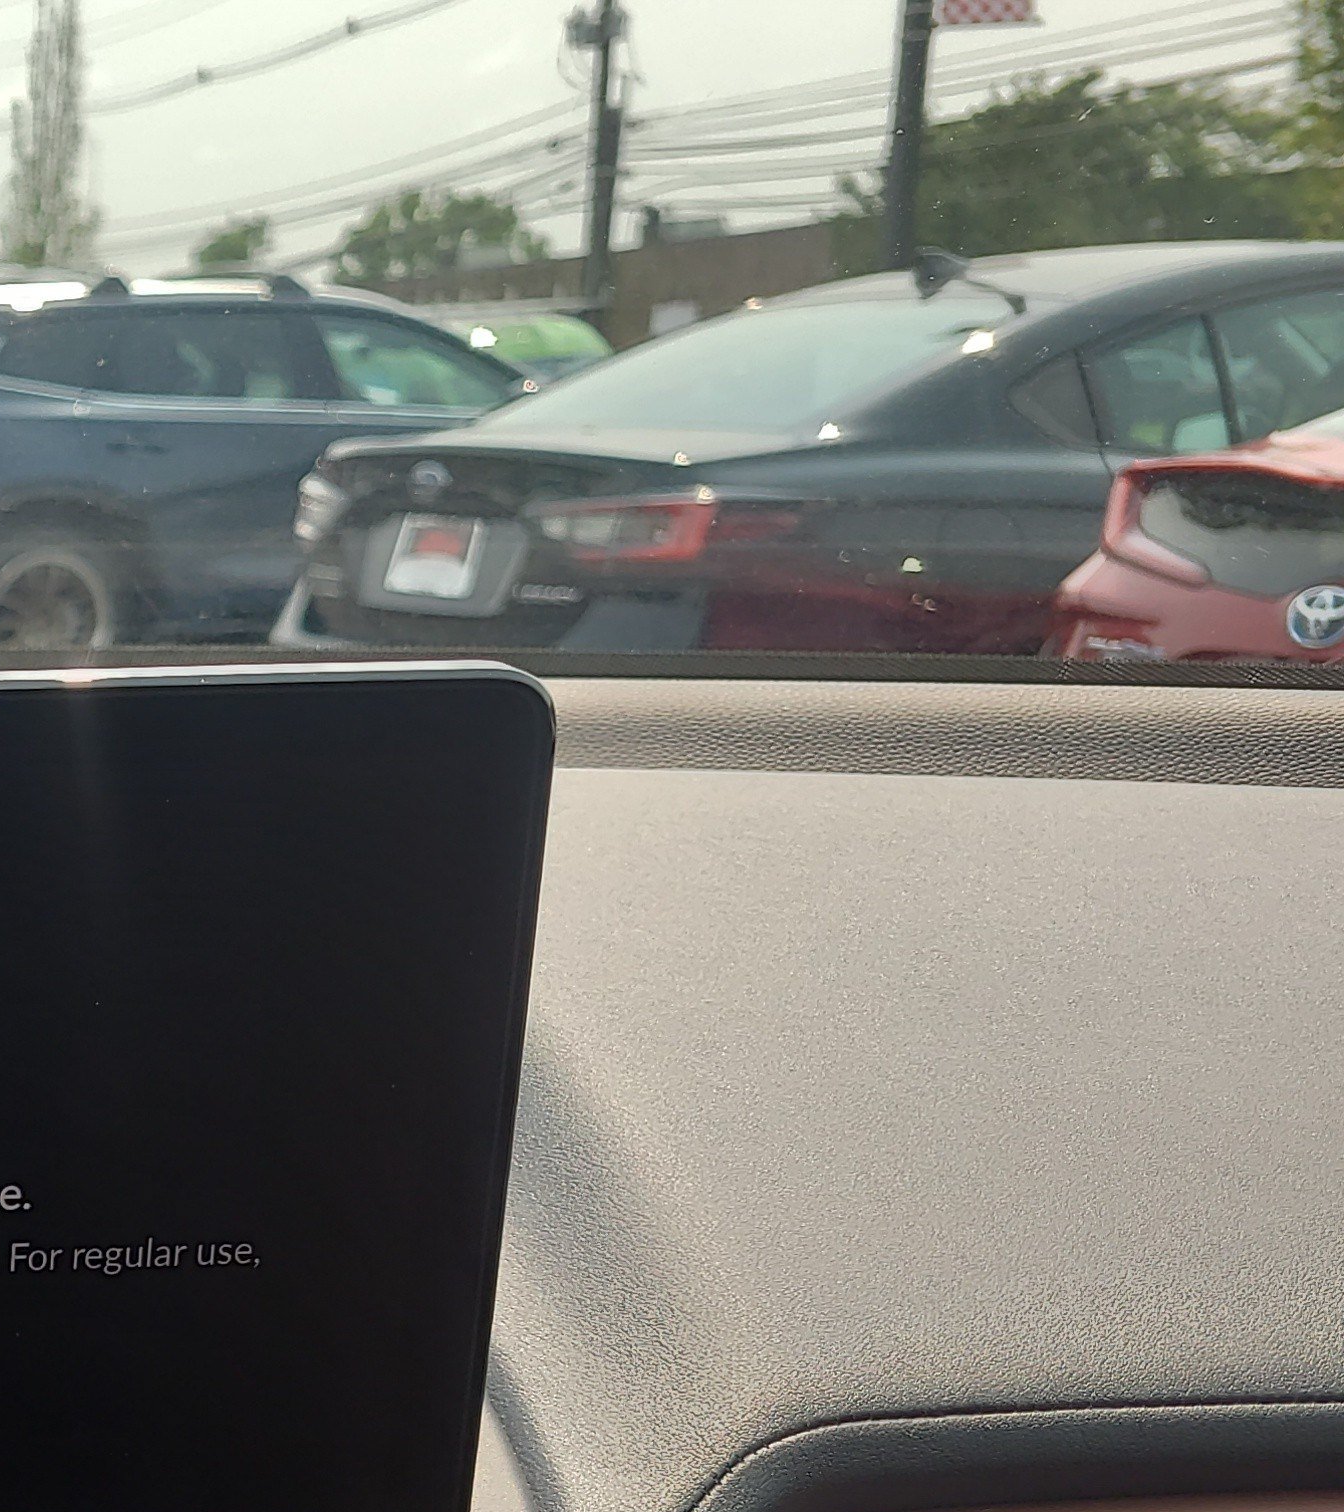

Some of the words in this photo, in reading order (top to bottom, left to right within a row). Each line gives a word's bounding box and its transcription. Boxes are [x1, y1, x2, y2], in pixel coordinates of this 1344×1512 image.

[11, 1243, 63, 1271] For
[73, 1238, 187, 1275] regular
[198, 1244, 259, 1268] use,
